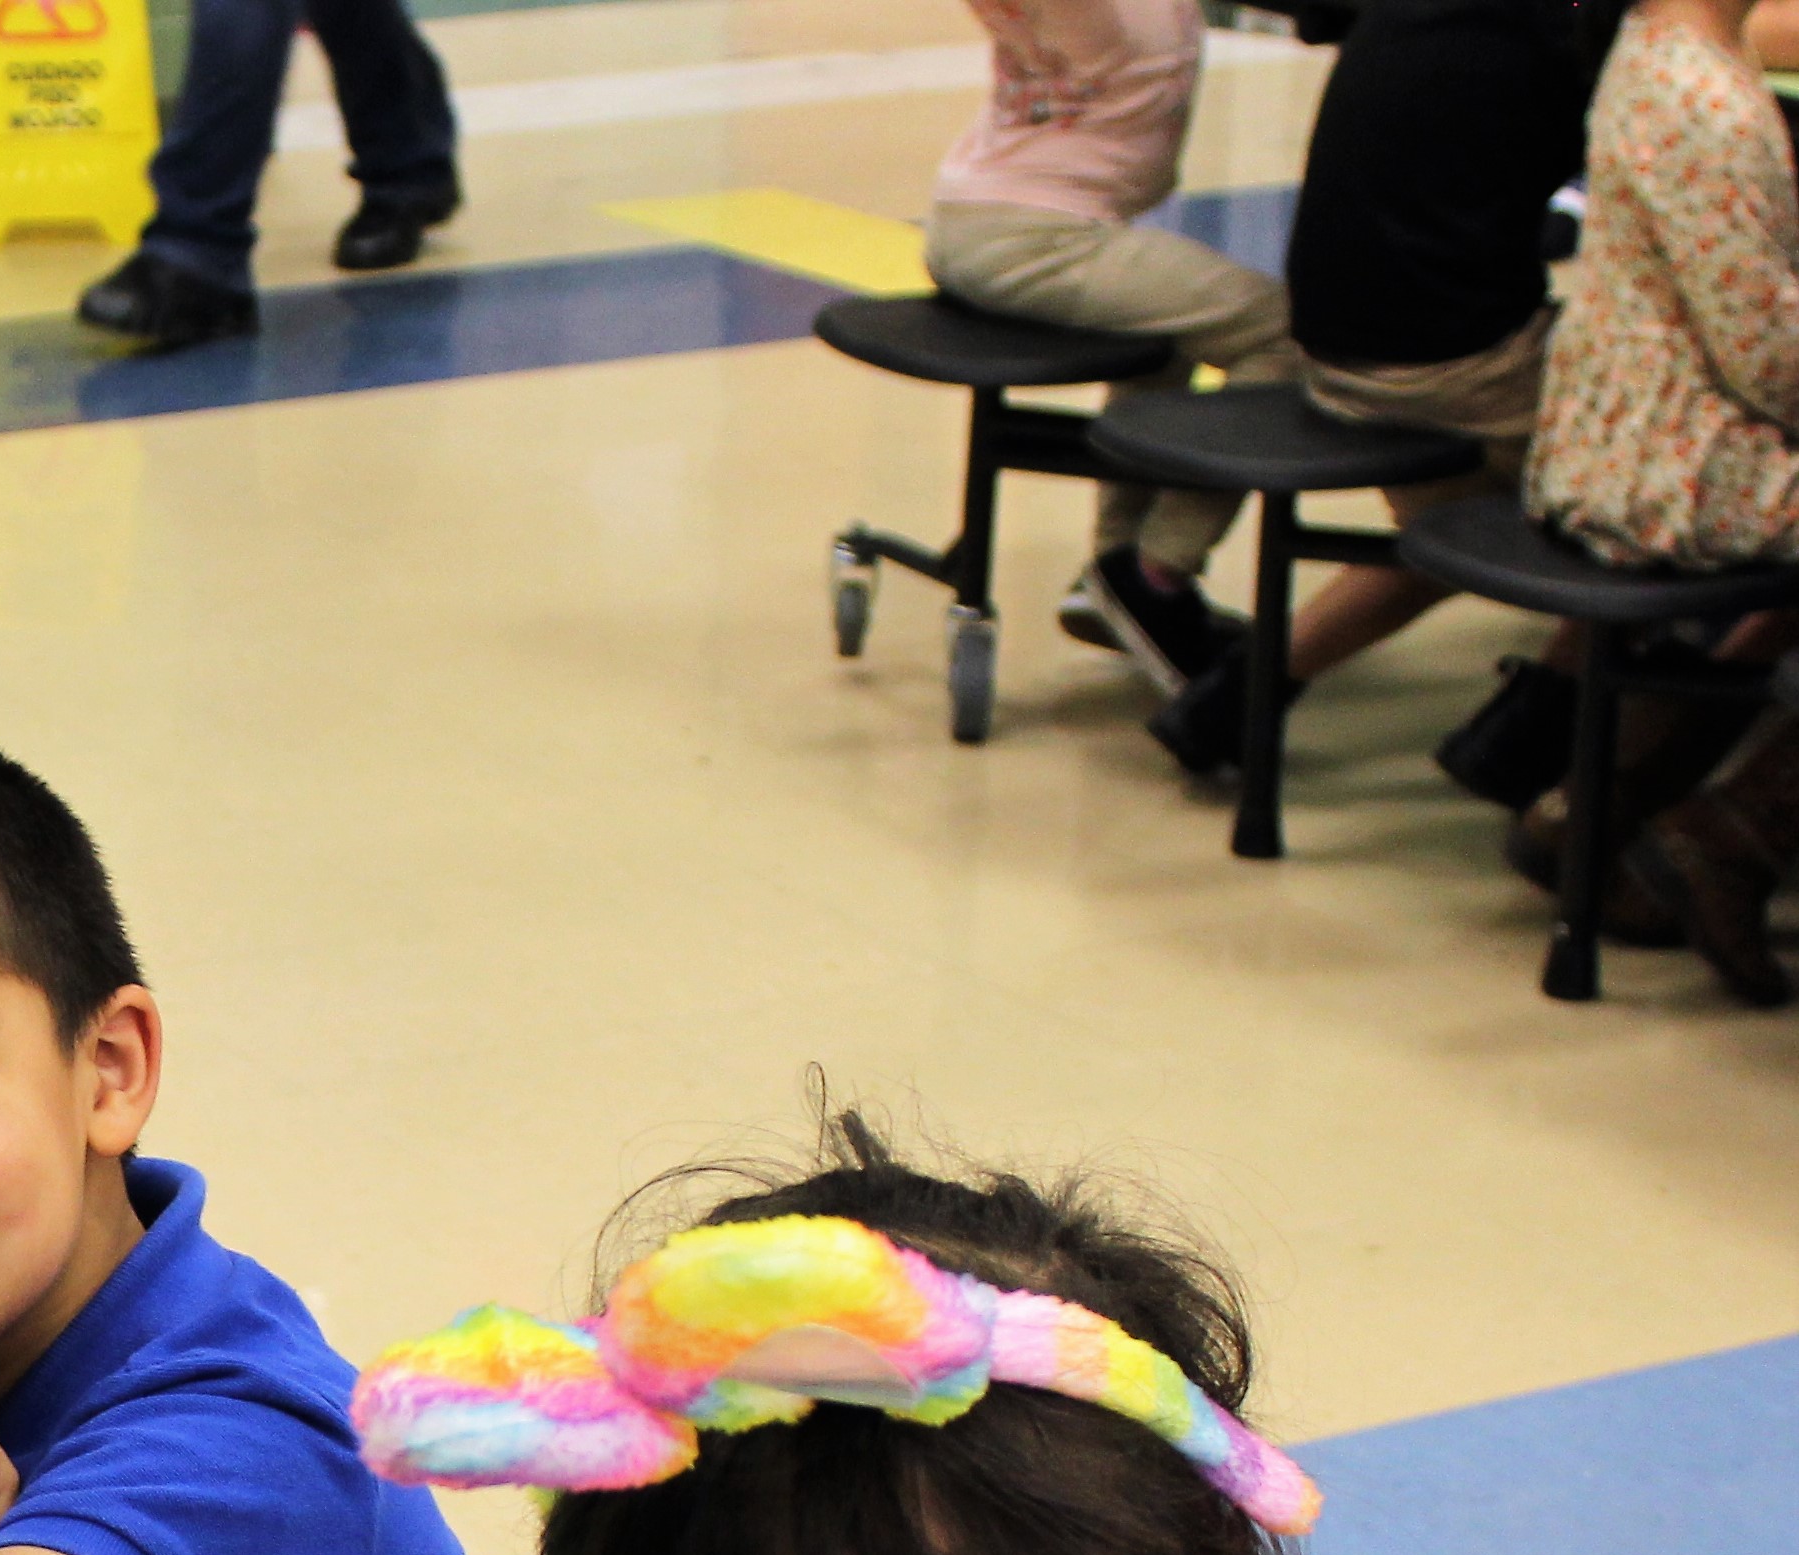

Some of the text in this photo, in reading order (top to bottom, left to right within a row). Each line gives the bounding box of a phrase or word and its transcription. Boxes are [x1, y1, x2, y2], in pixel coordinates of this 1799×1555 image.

[6, 61, 103, 81] CUIDADO
[28, 84, 79, 102] PISO
[9, 109, 103, 128] MOJADO
